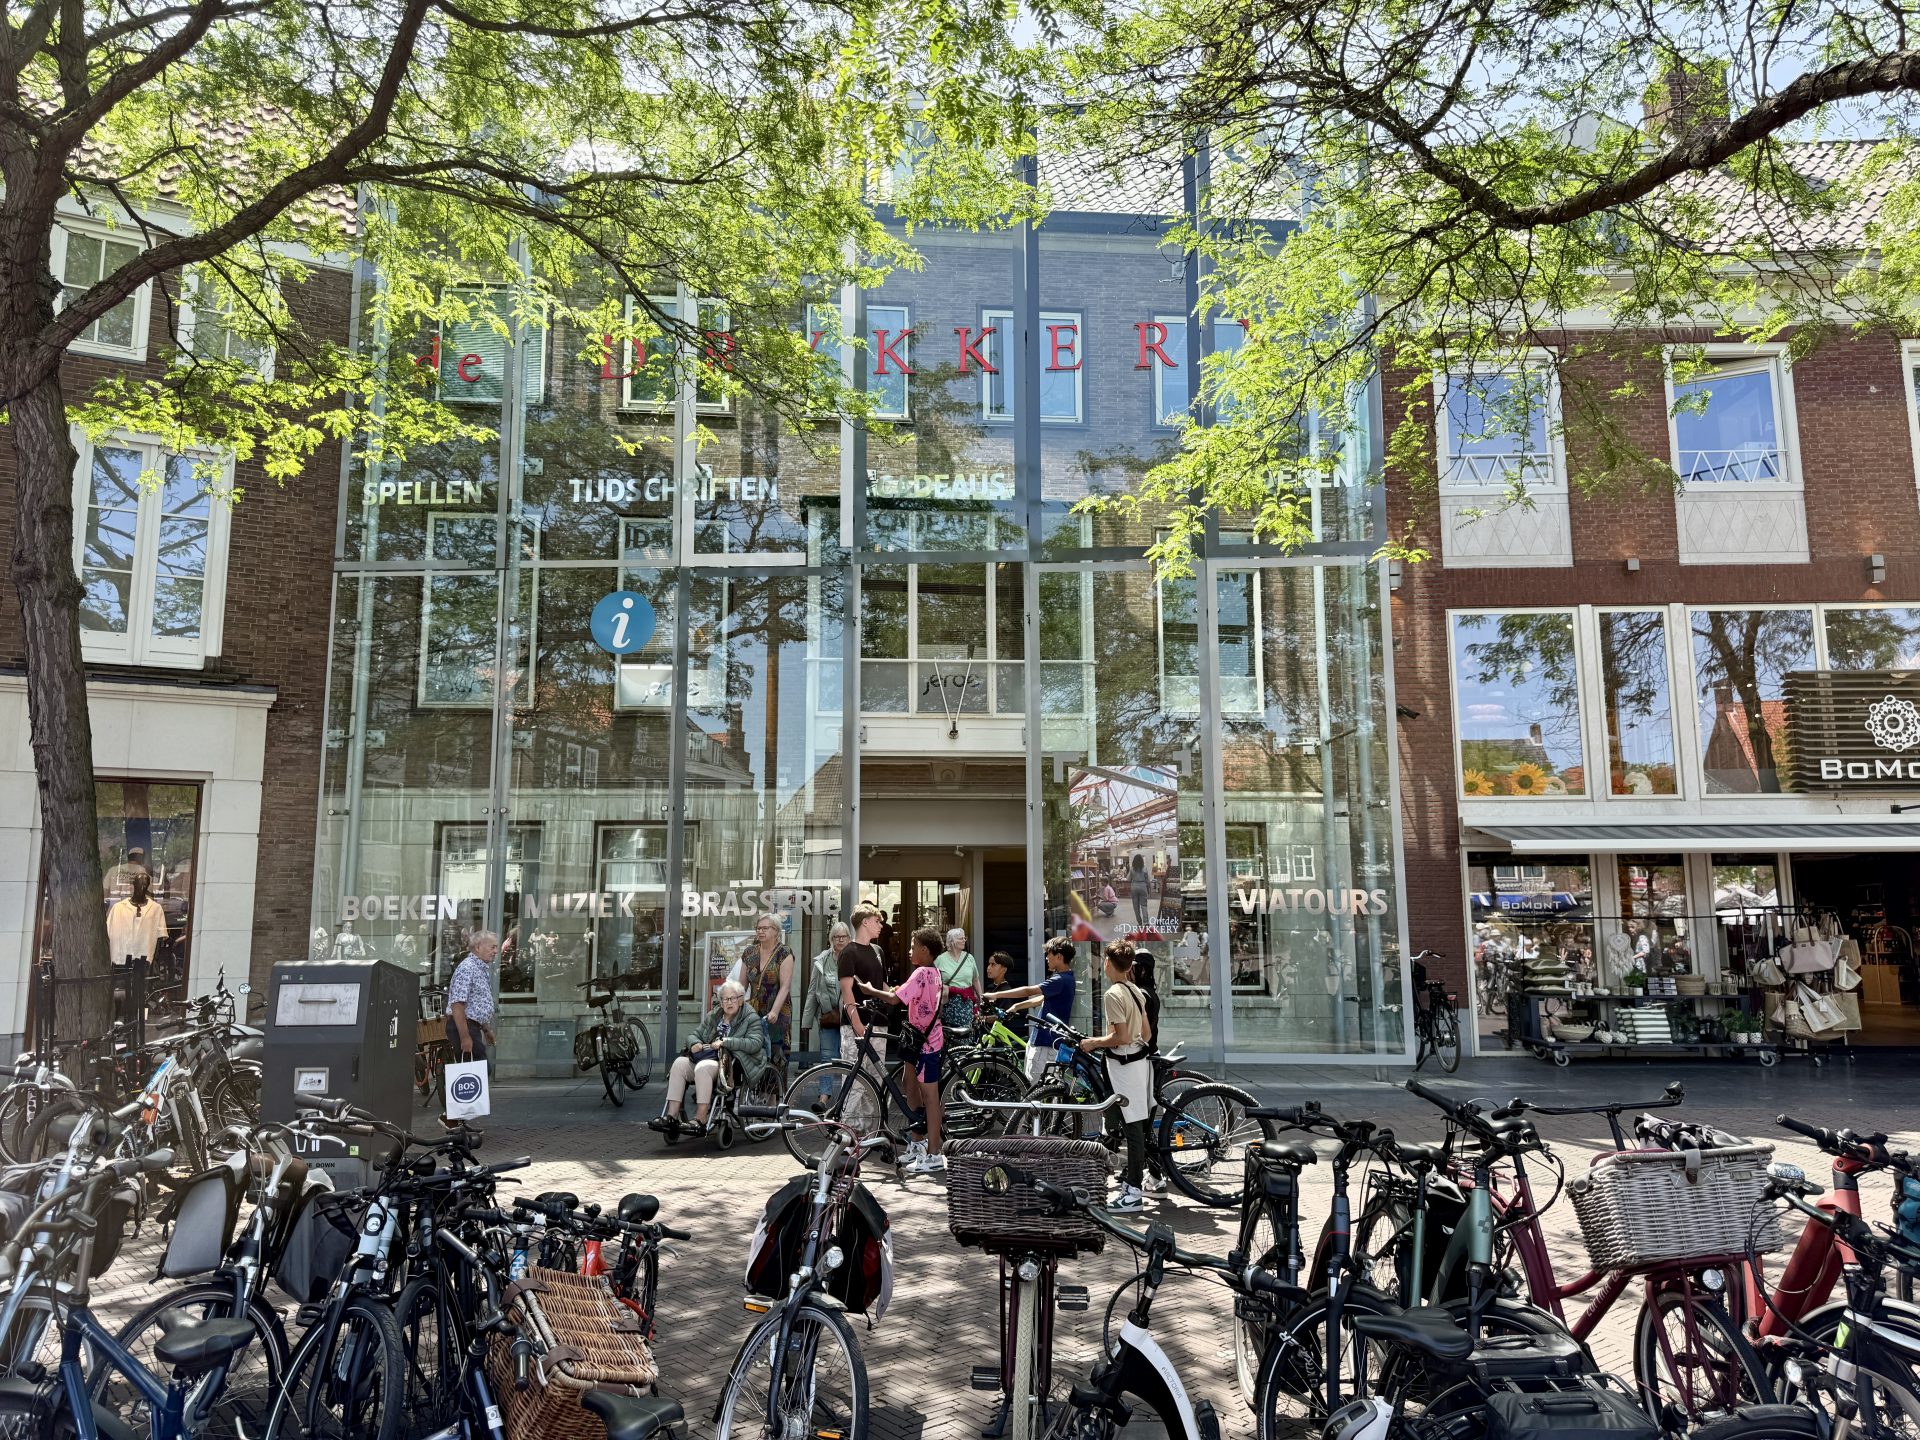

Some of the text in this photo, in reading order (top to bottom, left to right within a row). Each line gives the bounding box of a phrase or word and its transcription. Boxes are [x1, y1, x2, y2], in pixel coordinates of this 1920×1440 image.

[362, 480, 482, 505] SPELLEN
[569, 477, 778, 502] TIJDSCHRIFTEN
[876, 472, 1006, 499] CADEAUS
[341, 895, 458, 921] BOEKEN
[524, 892, 636, 919] MUZIEK
[1237, 888, 1388, 915] VIATOURS
[1149, 916, 1179, 925] Ontdek
[458, 1082, 475, 1091] BOS
